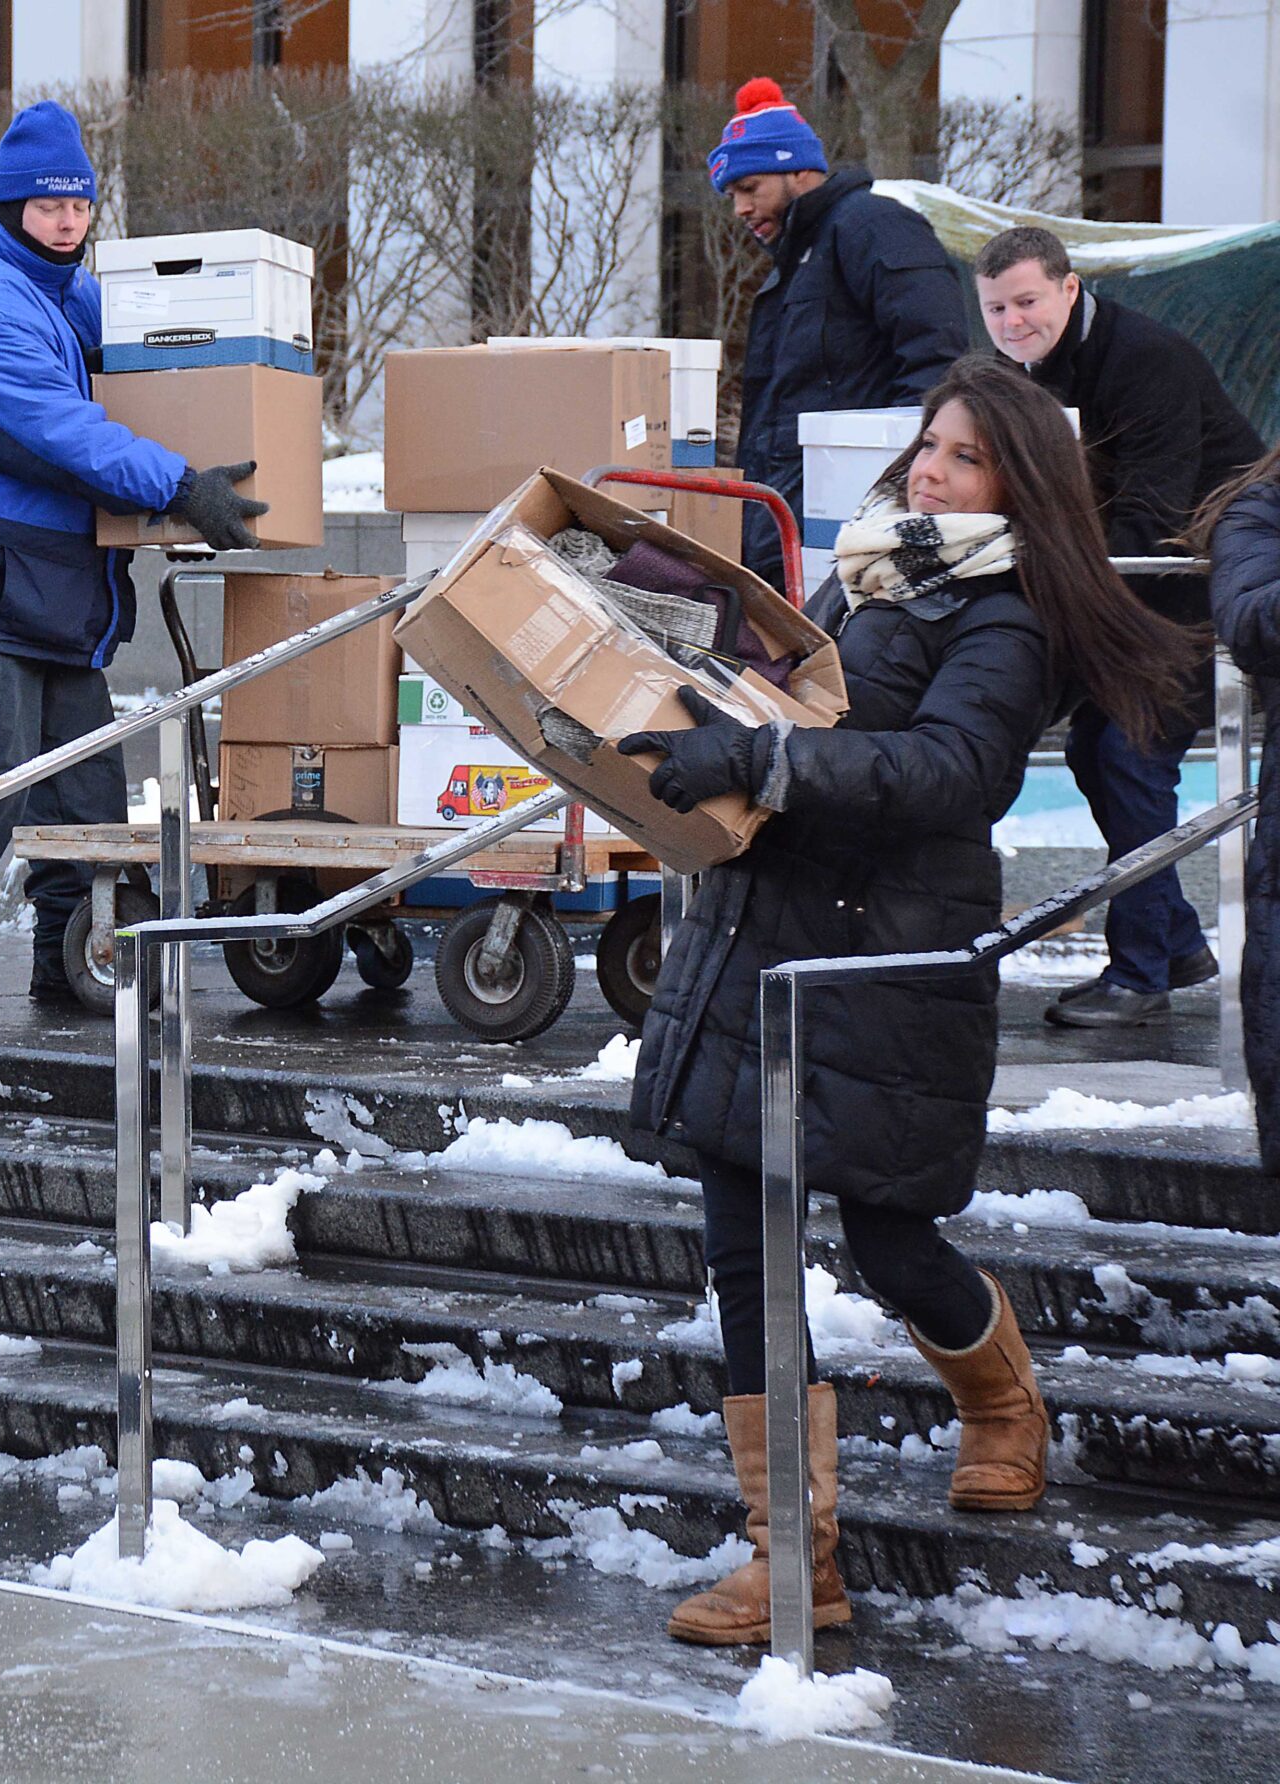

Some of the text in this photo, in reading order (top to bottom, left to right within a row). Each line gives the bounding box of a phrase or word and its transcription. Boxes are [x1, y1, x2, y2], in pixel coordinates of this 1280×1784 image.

[147, 332, 212, 344] BANKERS BOX
[295, 770, 321, 781] prime
